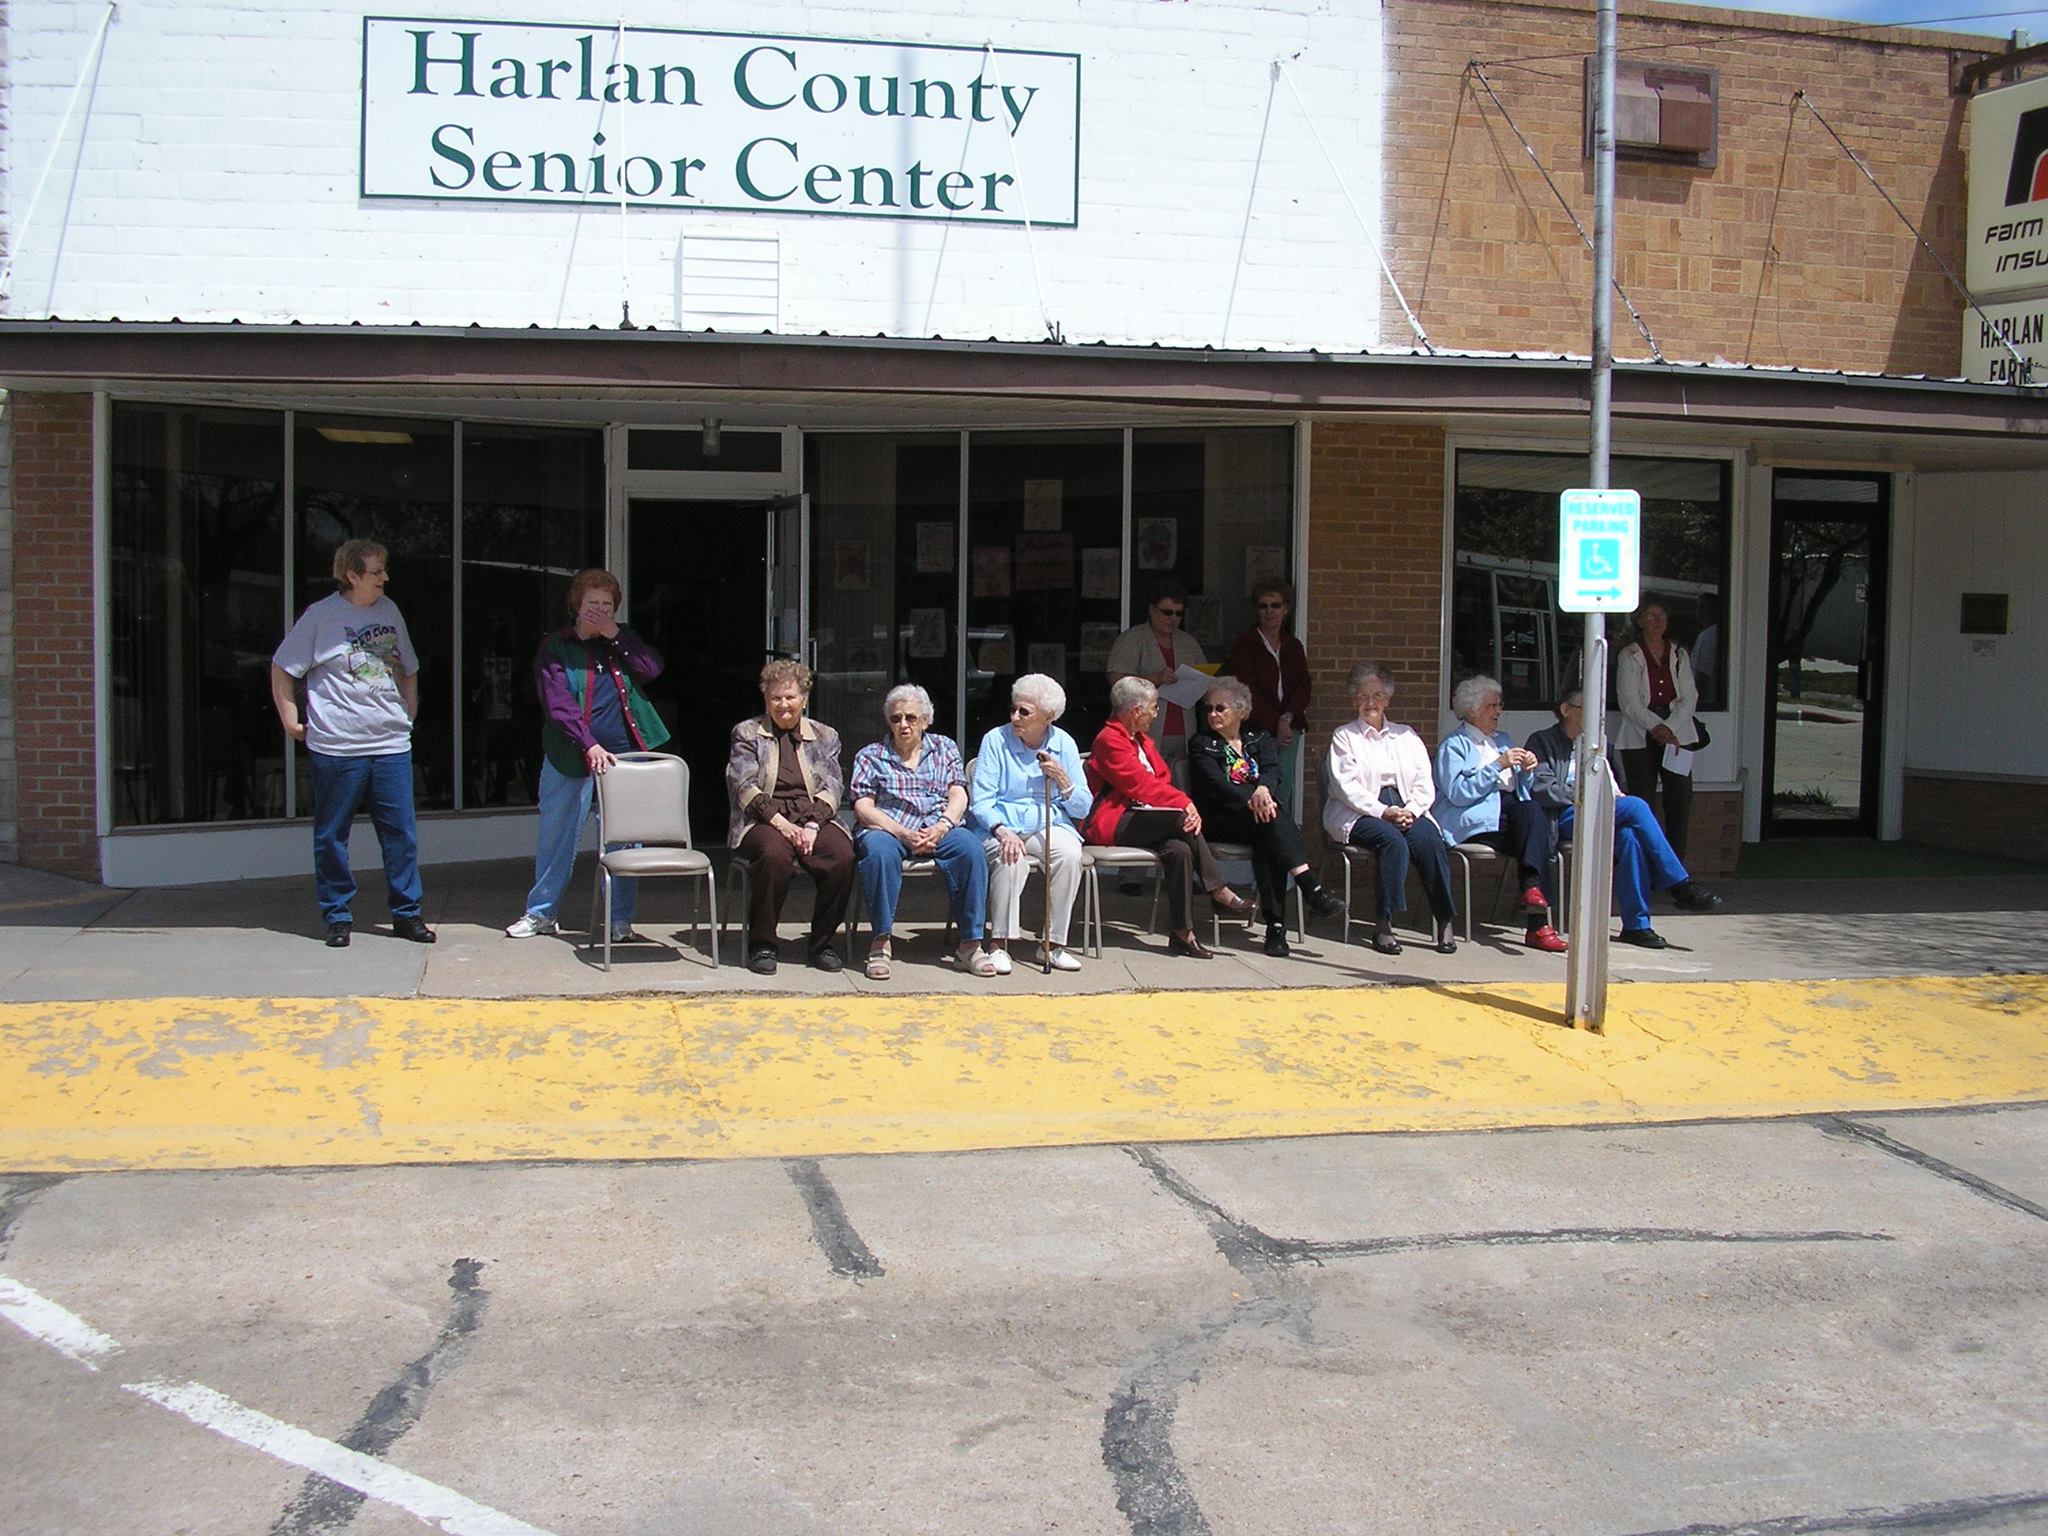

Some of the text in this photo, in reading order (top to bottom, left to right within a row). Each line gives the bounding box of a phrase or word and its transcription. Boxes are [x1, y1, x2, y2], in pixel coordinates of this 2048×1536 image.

[405, 29, 1041, 138] Harlan County
[429, 123, 1017, 213] Senior Center
[1980, 314, 2044, 348] HARLAN
[1568, 502, 1634, 515] RESERVED
[1573, 520, 1629, 533] PARKING
